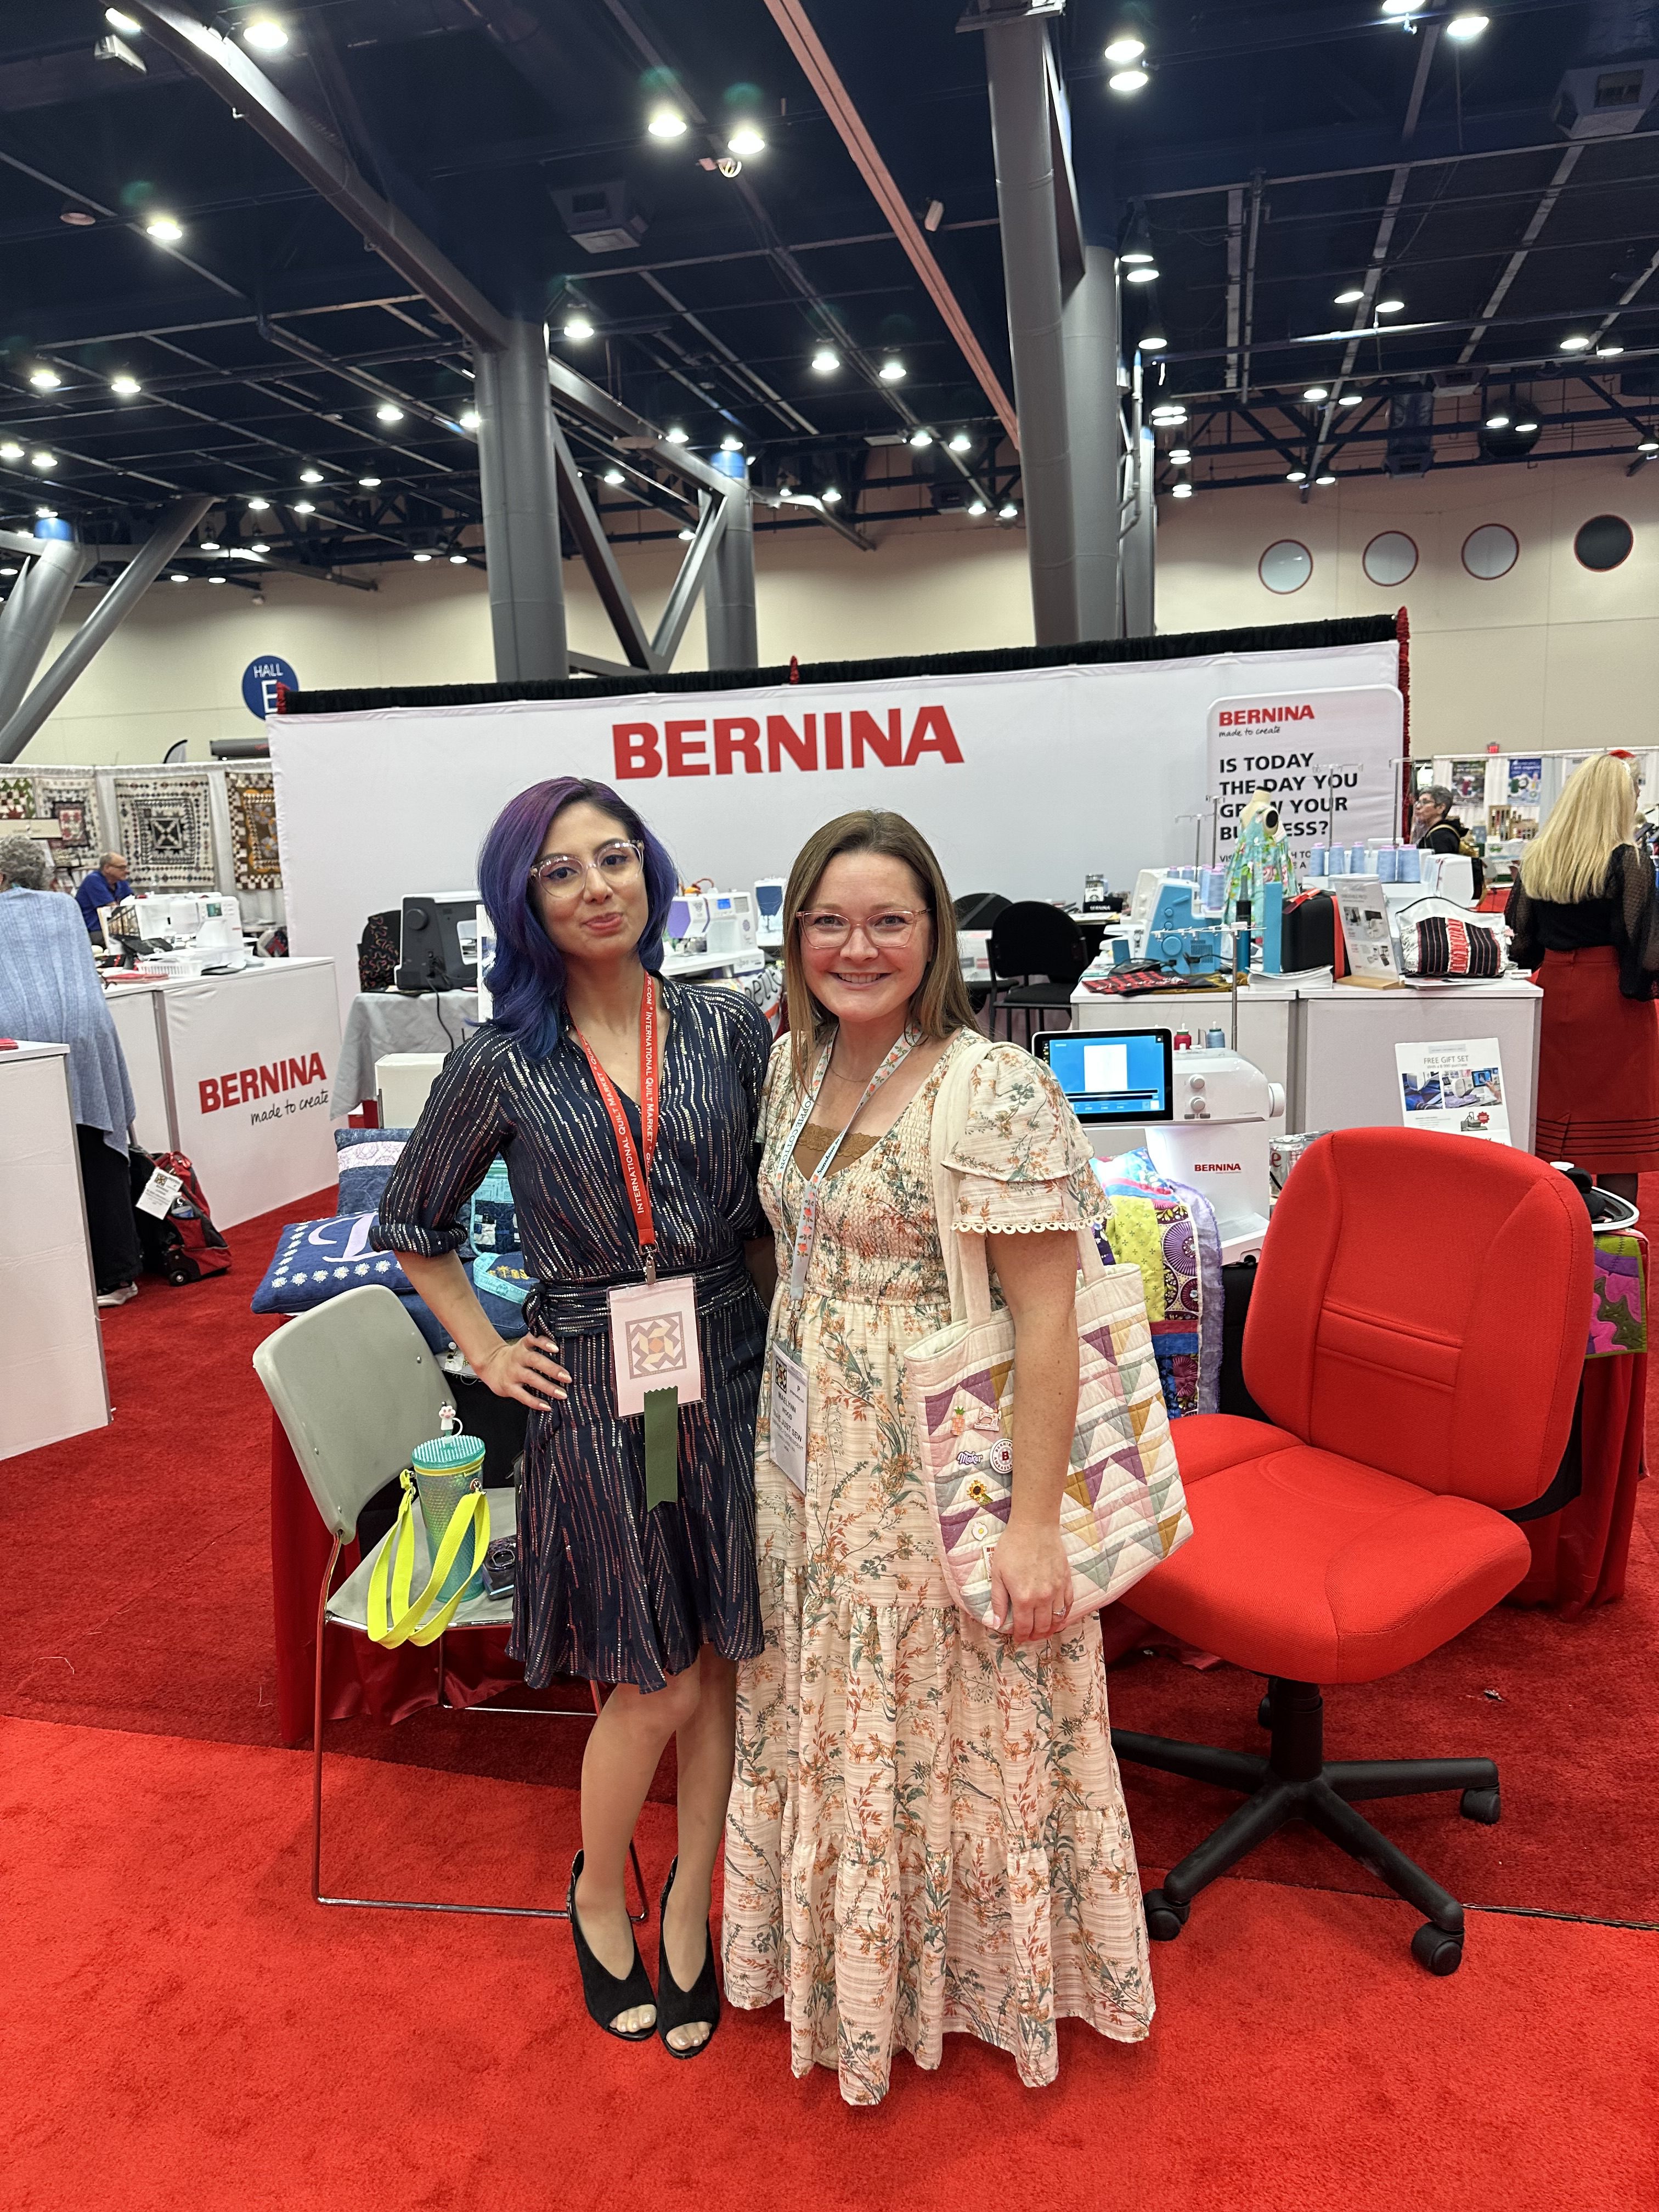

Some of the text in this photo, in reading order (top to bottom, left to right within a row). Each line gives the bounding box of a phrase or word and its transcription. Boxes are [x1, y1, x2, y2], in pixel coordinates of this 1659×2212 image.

[253, 663, 284, 679] HALL
[261, 680, 278, 713] E
[1218, 704, 1315, 727] BERNINA
[612, 705, 964, 780] BERNINA
[1218, 725, 1281, 738] made to create
[1219, 752, 1314, 774] IS TODAY
[1218, 772, 1358, 796] THE DAY YOU
[1219, 797, 1348, 819] GRW YOUR
[645, 1011, 653, 1076] INTERNATIONAL
[1423, 1057, 1440, 1065] FREE
[198, 1051, 327, 1115] BERNINA
[596, 1071, 617, 1107] MARKET
[645, 1077, 654, 1102] QUILT
[250, 1088, 329, 1126] made to create
[611, 1107, 627, 1135] QUILT
[645, 1103, 655, 1144] MARKET
[780, 1128, 799, 1170] COTTON
[622, 1136, 645, 1215] INTERNATIONAL
[1194, 1163, 1242, 1172] BERNINA
[777, 1391, 797, 1414] MAELYNN
[782, 1406, 793, 1420] WOOD
[781, 1418, 792, 1433] JUST
[792, 1428, 802, 1442] SEW
[956, 1450, 984, 1465] Maker
[994, 1457, 1013, 1470] AMBASSA
[1001, 1451, 1010, 1461] B
